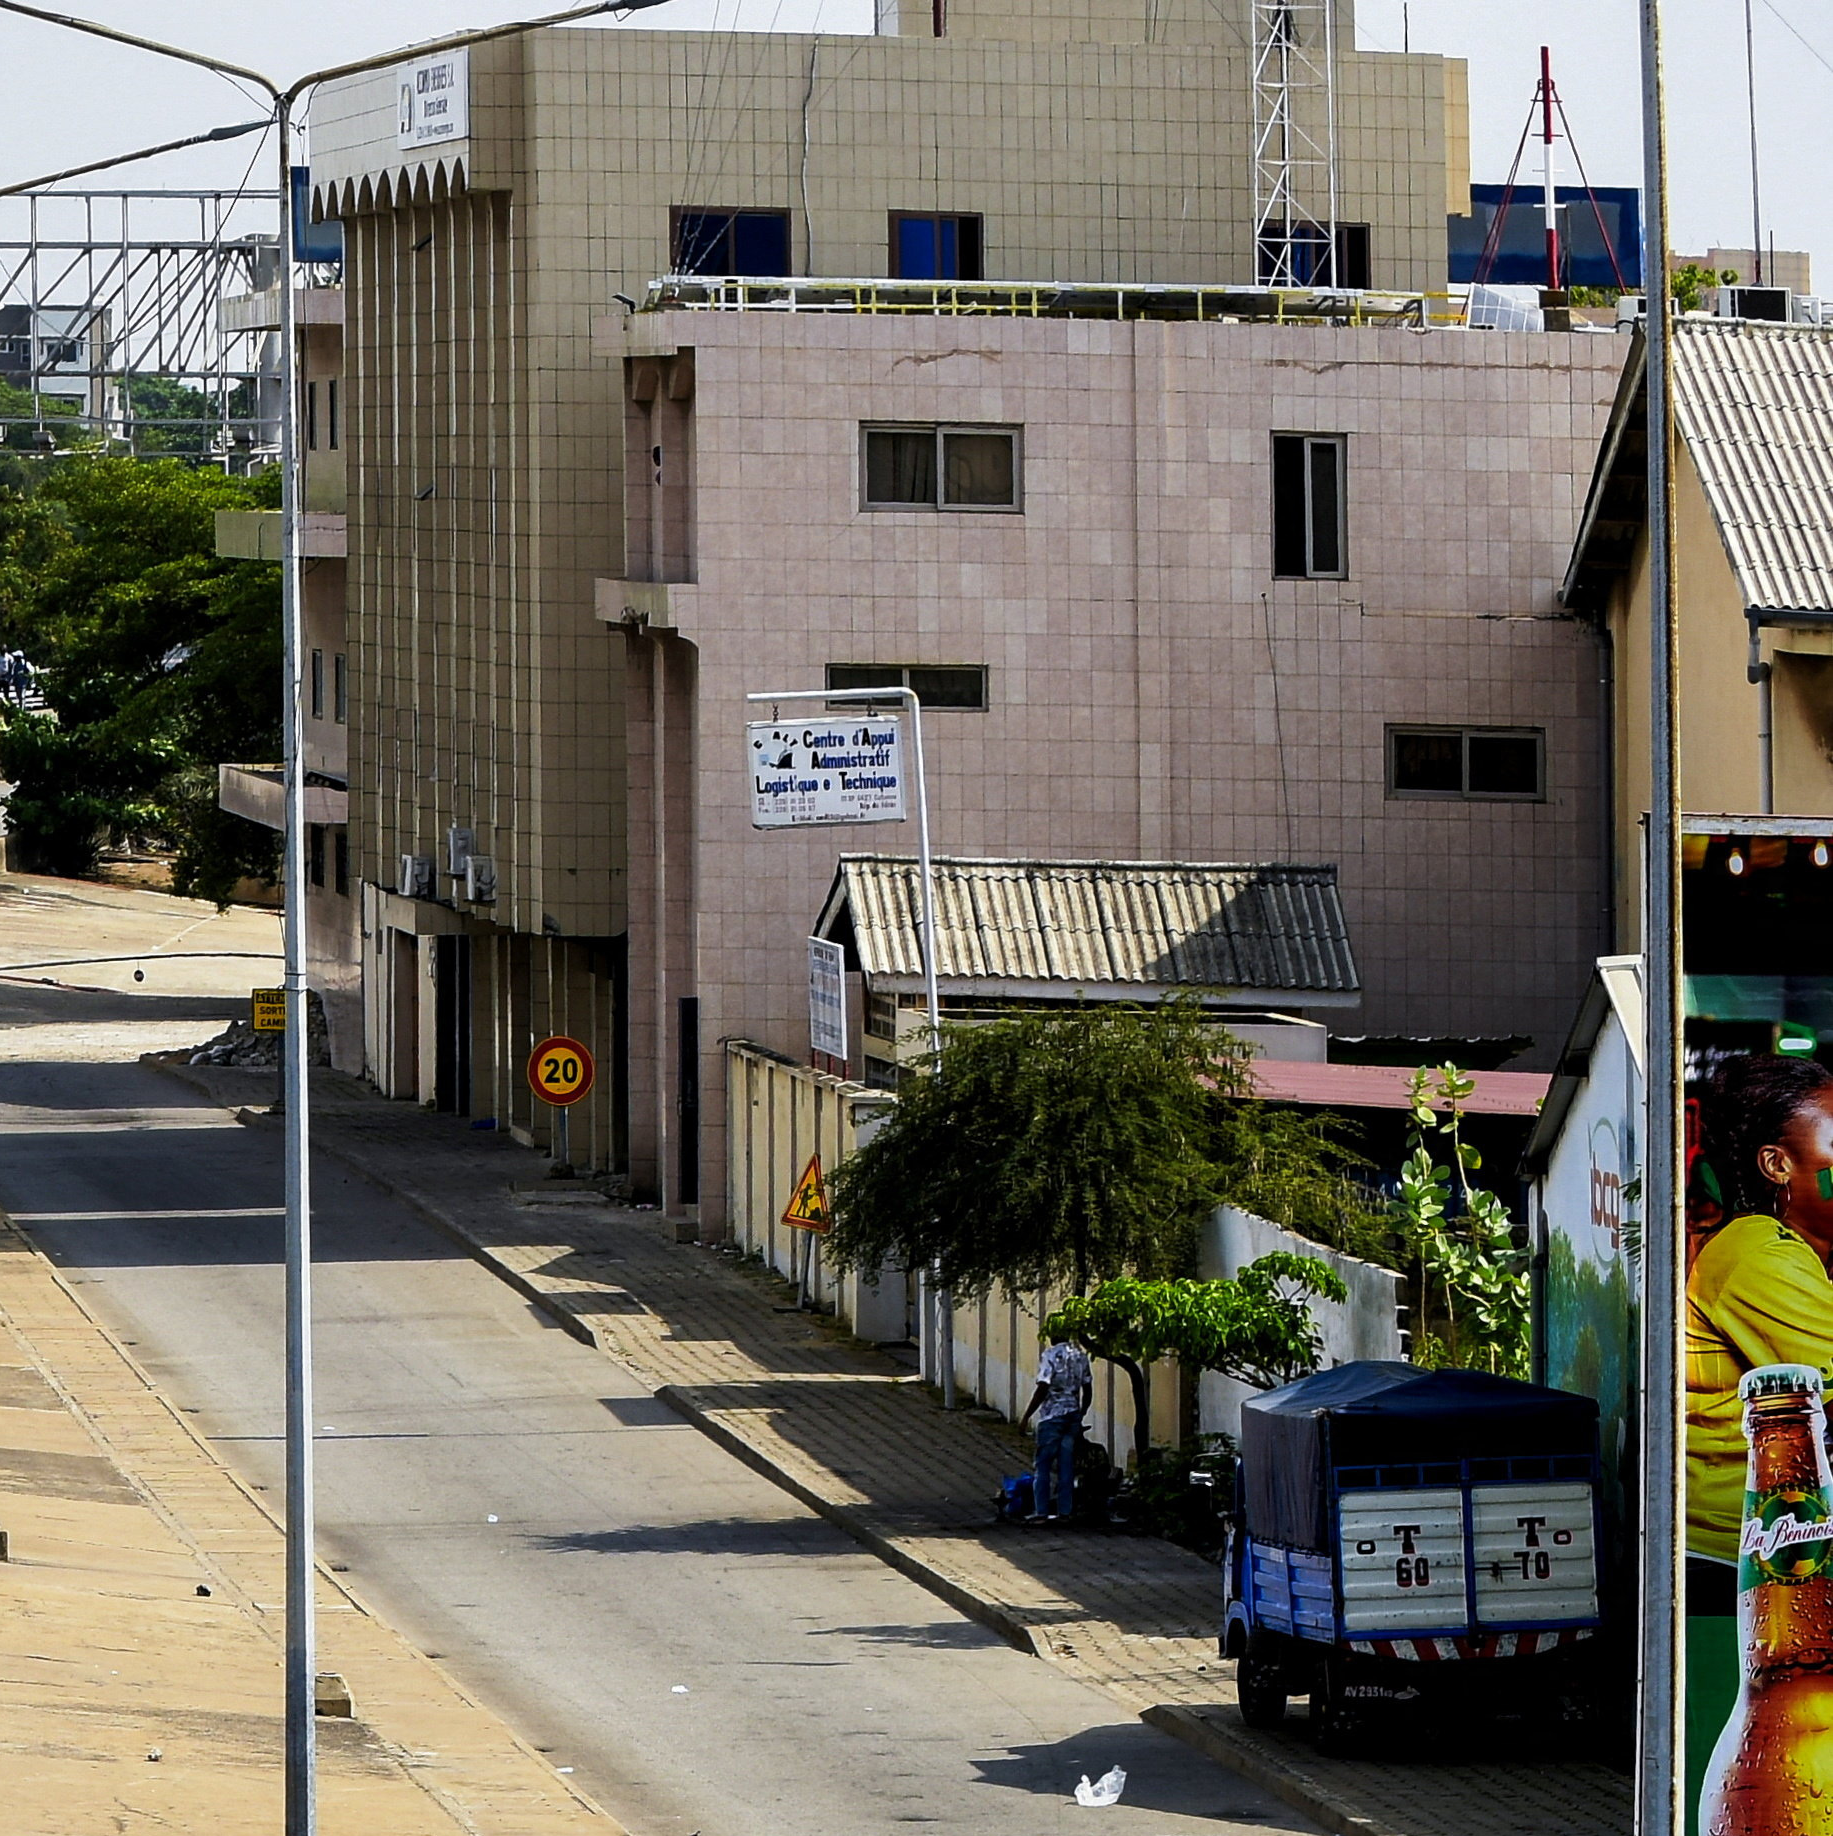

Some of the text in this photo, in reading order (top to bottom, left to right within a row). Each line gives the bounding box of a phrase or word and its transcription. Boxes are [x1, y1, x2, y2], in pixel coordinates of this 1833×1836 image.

[803, 727, 895, 750] Centre d'Appui
[811, 749, 890, 770] Administratif
[839, 771, 897, 795] Technique
[544, 1057, 578, 1084] 20
[1742, 1522, 1765, 1550] La
[1396, 1557, 1430, 1588] 60
[1513, 1551, 1550, 1580] 70
